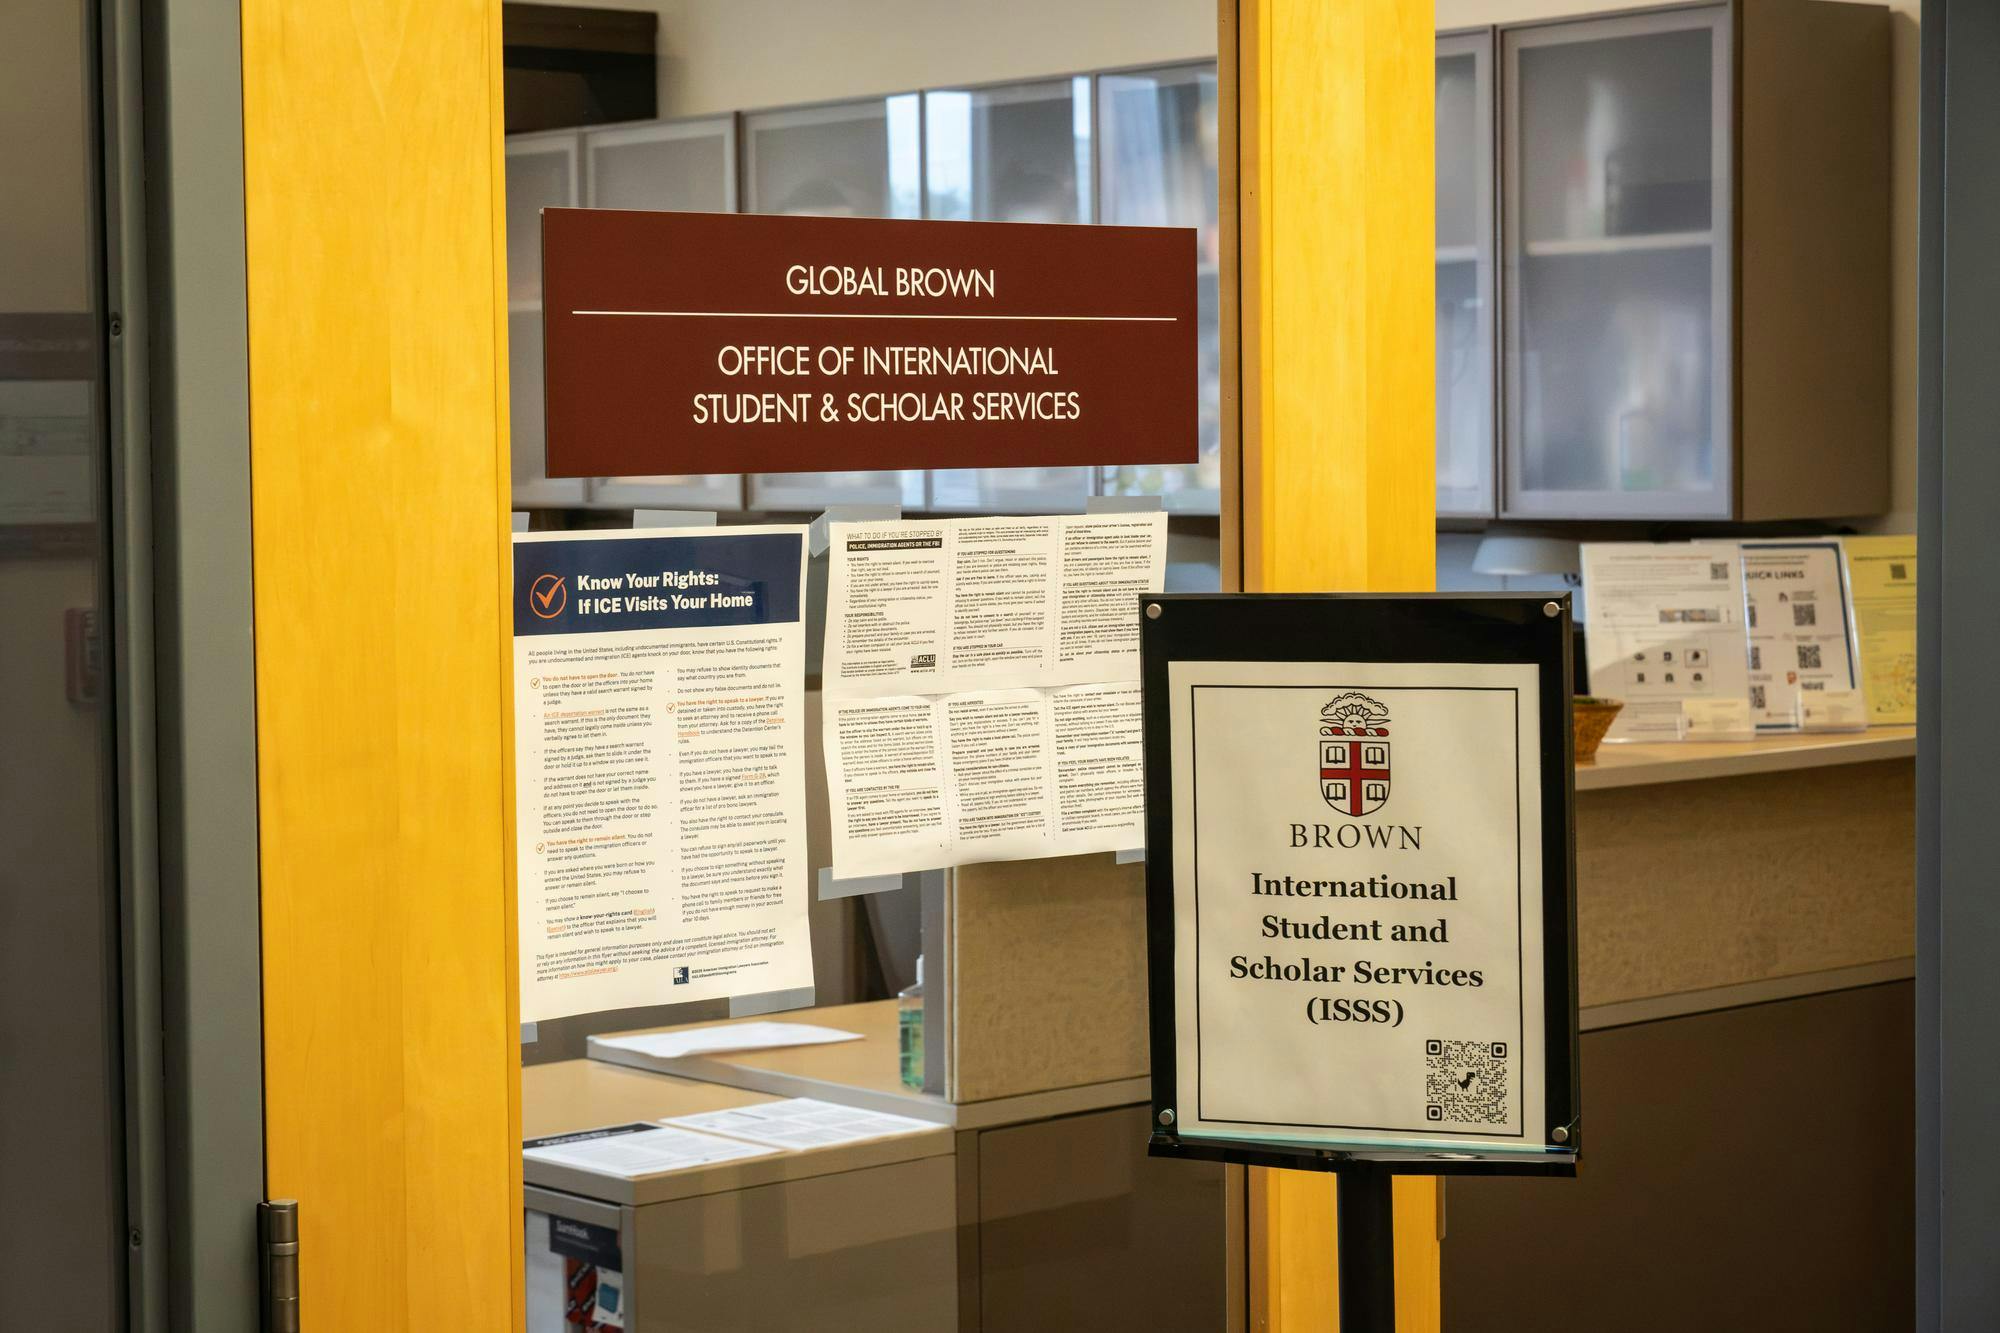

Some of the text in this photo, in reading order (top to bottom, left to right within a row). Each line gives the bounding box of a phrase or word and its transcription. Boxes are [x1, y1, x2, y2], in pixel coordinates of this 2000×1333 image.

[787, 265, 994, 297] GLOBAL BROWN
[718, 346, 1058, 375] OFFICE OF INTERNATIONAL
[694, 392, 1080, 423] STUDENT & SCHOLAR SERVICES
[578, 571, 718, 590] Know Your Rights:
[1745, 570, 1773, 580] UICK
[579, 594, 753, 614] If ICE Visits Your Home
[1291, 824, 1421, 849] BROWN
[1252, 873, 1457, 900] International
[1262, 915, 1448, 942] Student and
[1231, 956, 1483, 987] Scholar Services
[1307, 997, 1403, 1027] (ISSS)
